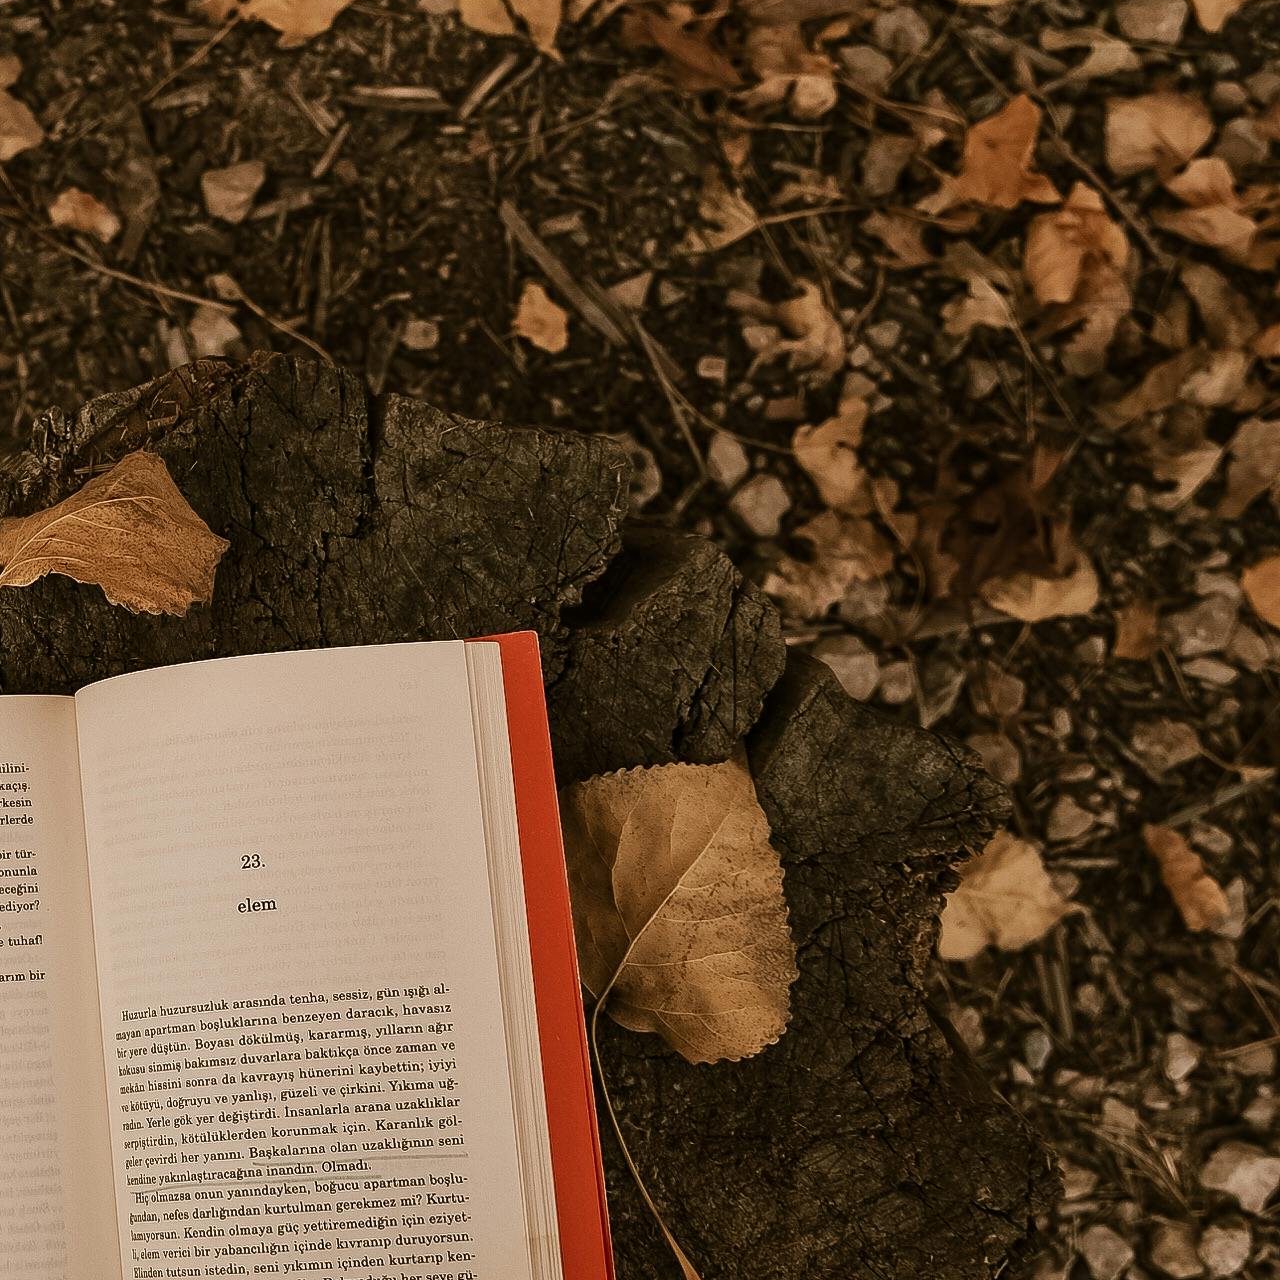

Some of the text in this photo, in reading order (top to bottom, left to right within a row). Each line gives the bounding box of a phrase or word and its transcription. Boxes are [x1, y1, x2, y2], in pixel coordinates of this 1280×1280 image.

[240, 854, 265, 869] 23.
[237, 897, 277, 913] elem
[29, 969, 46, 981] bir
[122, 982, 450, 1022] Huzurla huzursuzluk arasında tenha, sessiz, gün ışığı al-
[115, 1003, 452, 1042] mayan apartman boşluklarına benzeyen daracık, havasız
[116, 1021, 454, 1060] bir yere düştün. Boyası dökülmüş, kararmış, yılların ağır
[118, 1041, 455, 1077] kokusu sinmiş bakımsız duvarlara baktıkça önce zaman ve
[147, 1077, 182, 1092] hissini
[185, 1077, 218, 1088] sonra
[221, 1073, 237, 1085] da
[240, 1071, 295, 1084] kavrayış
[299, 1064, 354, 1079] hünerini
[358, 1060, 424, 1077] kaybettin;
[428, 1057, 457, 1073] iyiyi
[124, 1114, 462, 1151] serpiştirdin, kötülüklerden korunmak için. Karanlık göl-
[125, 1133, 464, 1170] geler çevirdi her yanını. Başkalarına olan uzaklığının seni
[126, 1158, 372, 1186] kendine yakınlaştıracağına inandın. Olmadı.
[135, 1172, 468, 1206] Hiç olmazsa onun yanındayken, boğucu apartman boşlu-
[166, 1266, 201, 1278] tutsun
[204, 1263, 250, 1276] istedin,
[254, 1261, 280, 1274] seni
[283, 1259, 333, 1275] yıkımın
[337, 1255, 385, 1272] içinden
[388, 1253, 443, 1266] kurtarıp
[447, 1250, 476, 1262] ken-
